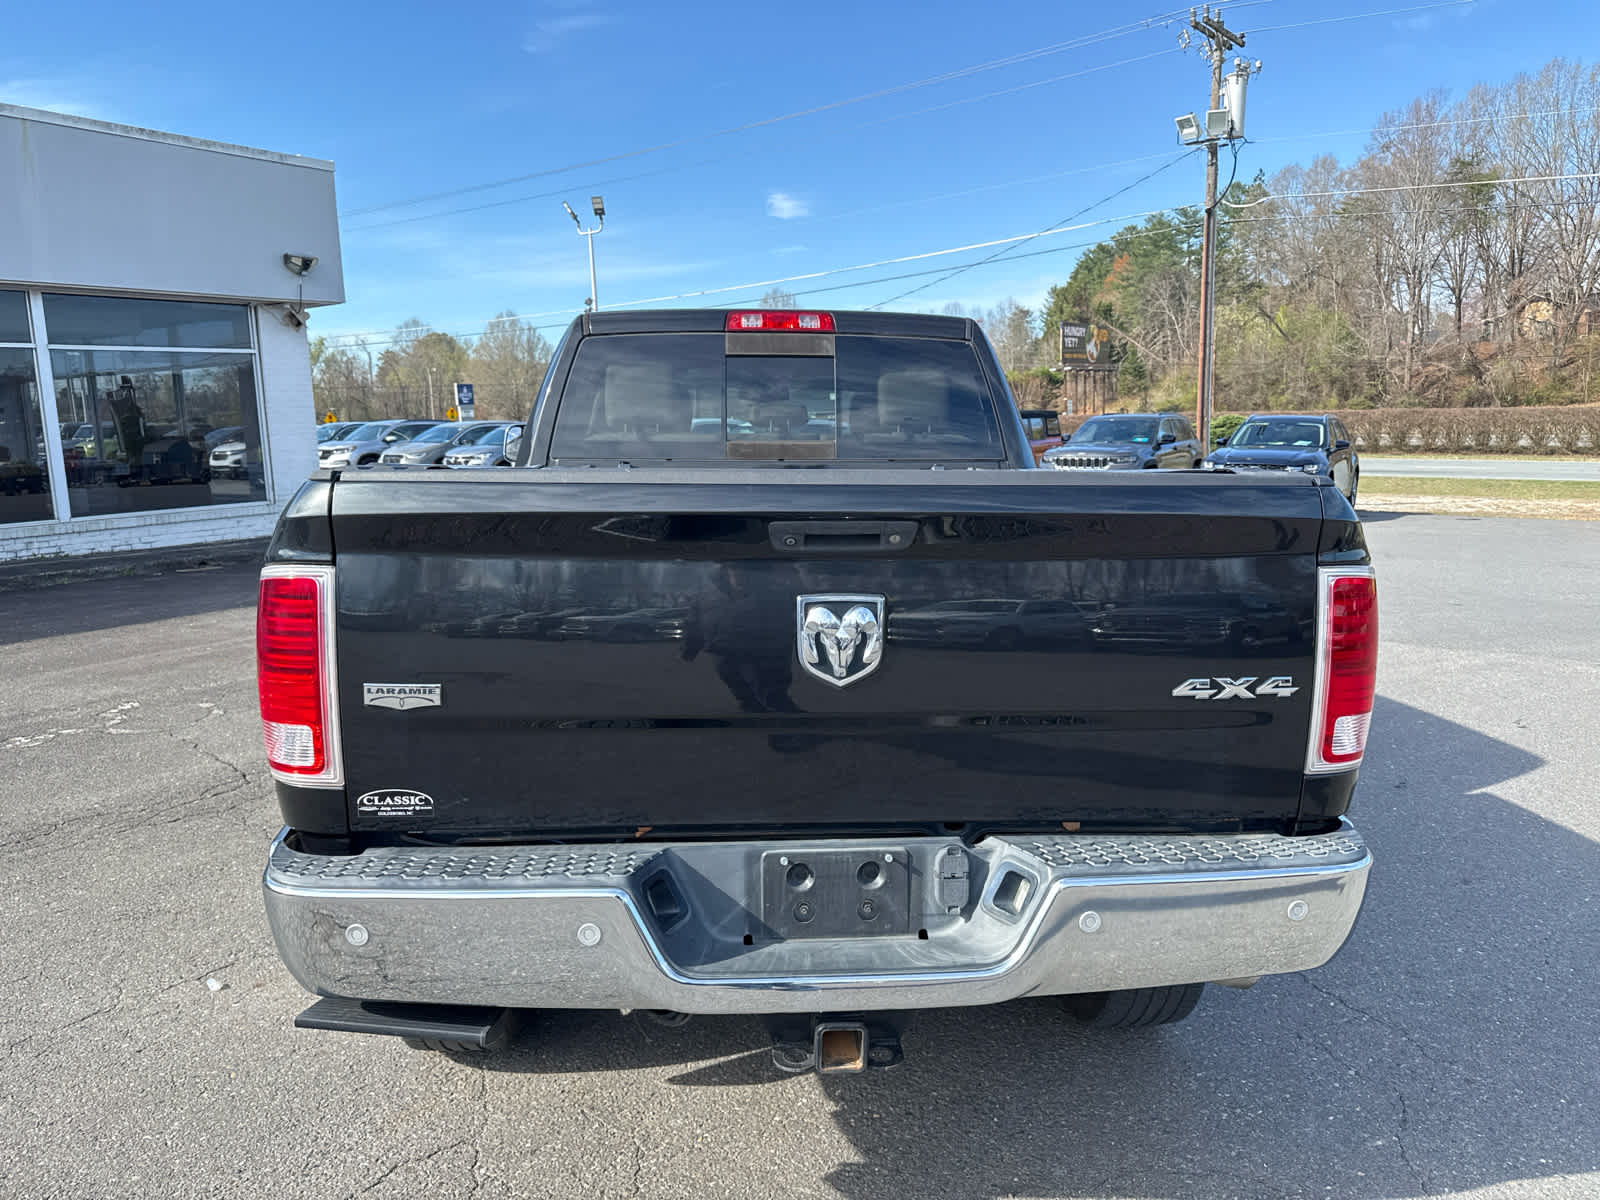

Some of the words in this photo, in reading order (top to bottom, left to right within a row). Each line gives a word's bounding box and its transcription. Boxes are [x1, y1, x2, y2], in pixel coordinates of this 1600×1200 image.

[1064, 326, 1086, 337] HUNGRY
[366, 687, 438, 695] LARAMIE
[1171, 676, 1300, 700] 4X4
[362, 795, 425, 805] CLASSIC
